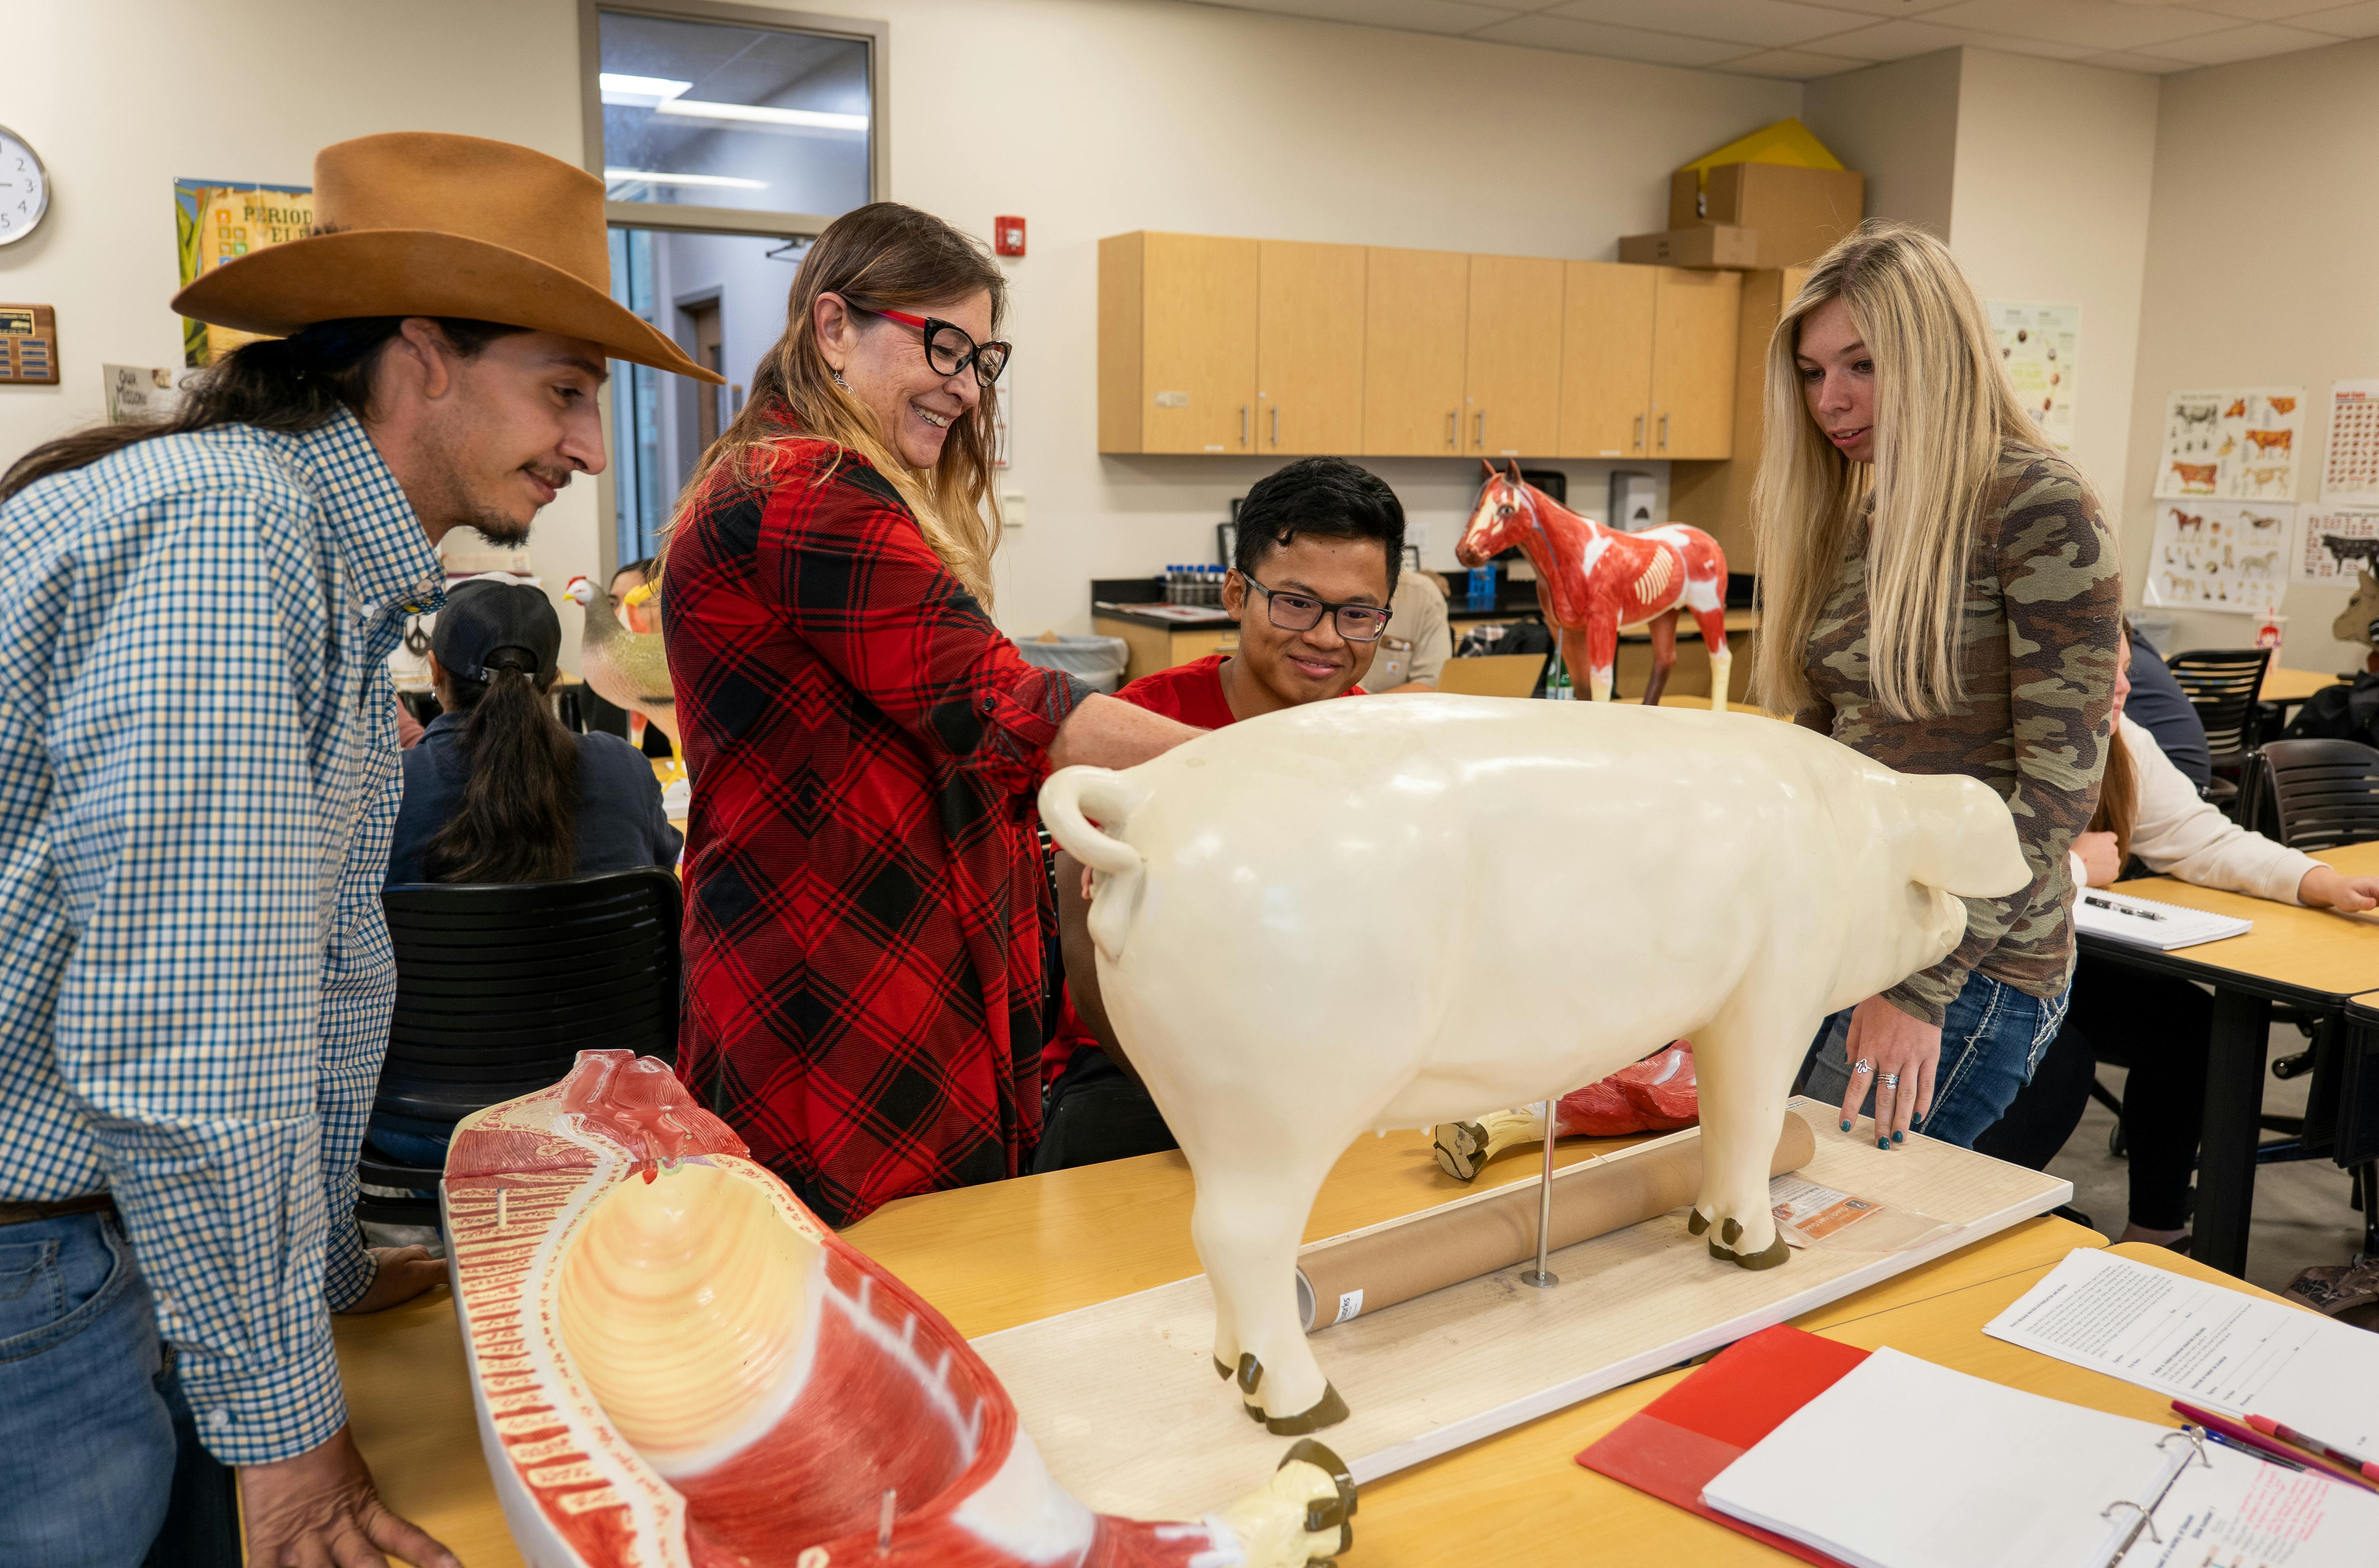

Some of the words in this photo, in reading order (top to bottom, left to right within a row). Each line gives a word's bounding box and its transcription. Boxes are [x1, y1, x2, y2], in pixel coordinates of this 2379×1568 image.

[15, 157, 26, 172] 2
[24, 178, 34, 193] 3
[17, 199, 28, 214] 4
[1, 213, 10, 229] 5
[1787, 1193, 1804, 1202] Includes:
[1804, 1187, 1820, 1197] Product
[1832, 1206, 1849, 1218] Quick
[1817, 1214, 1831, 1224] Start
